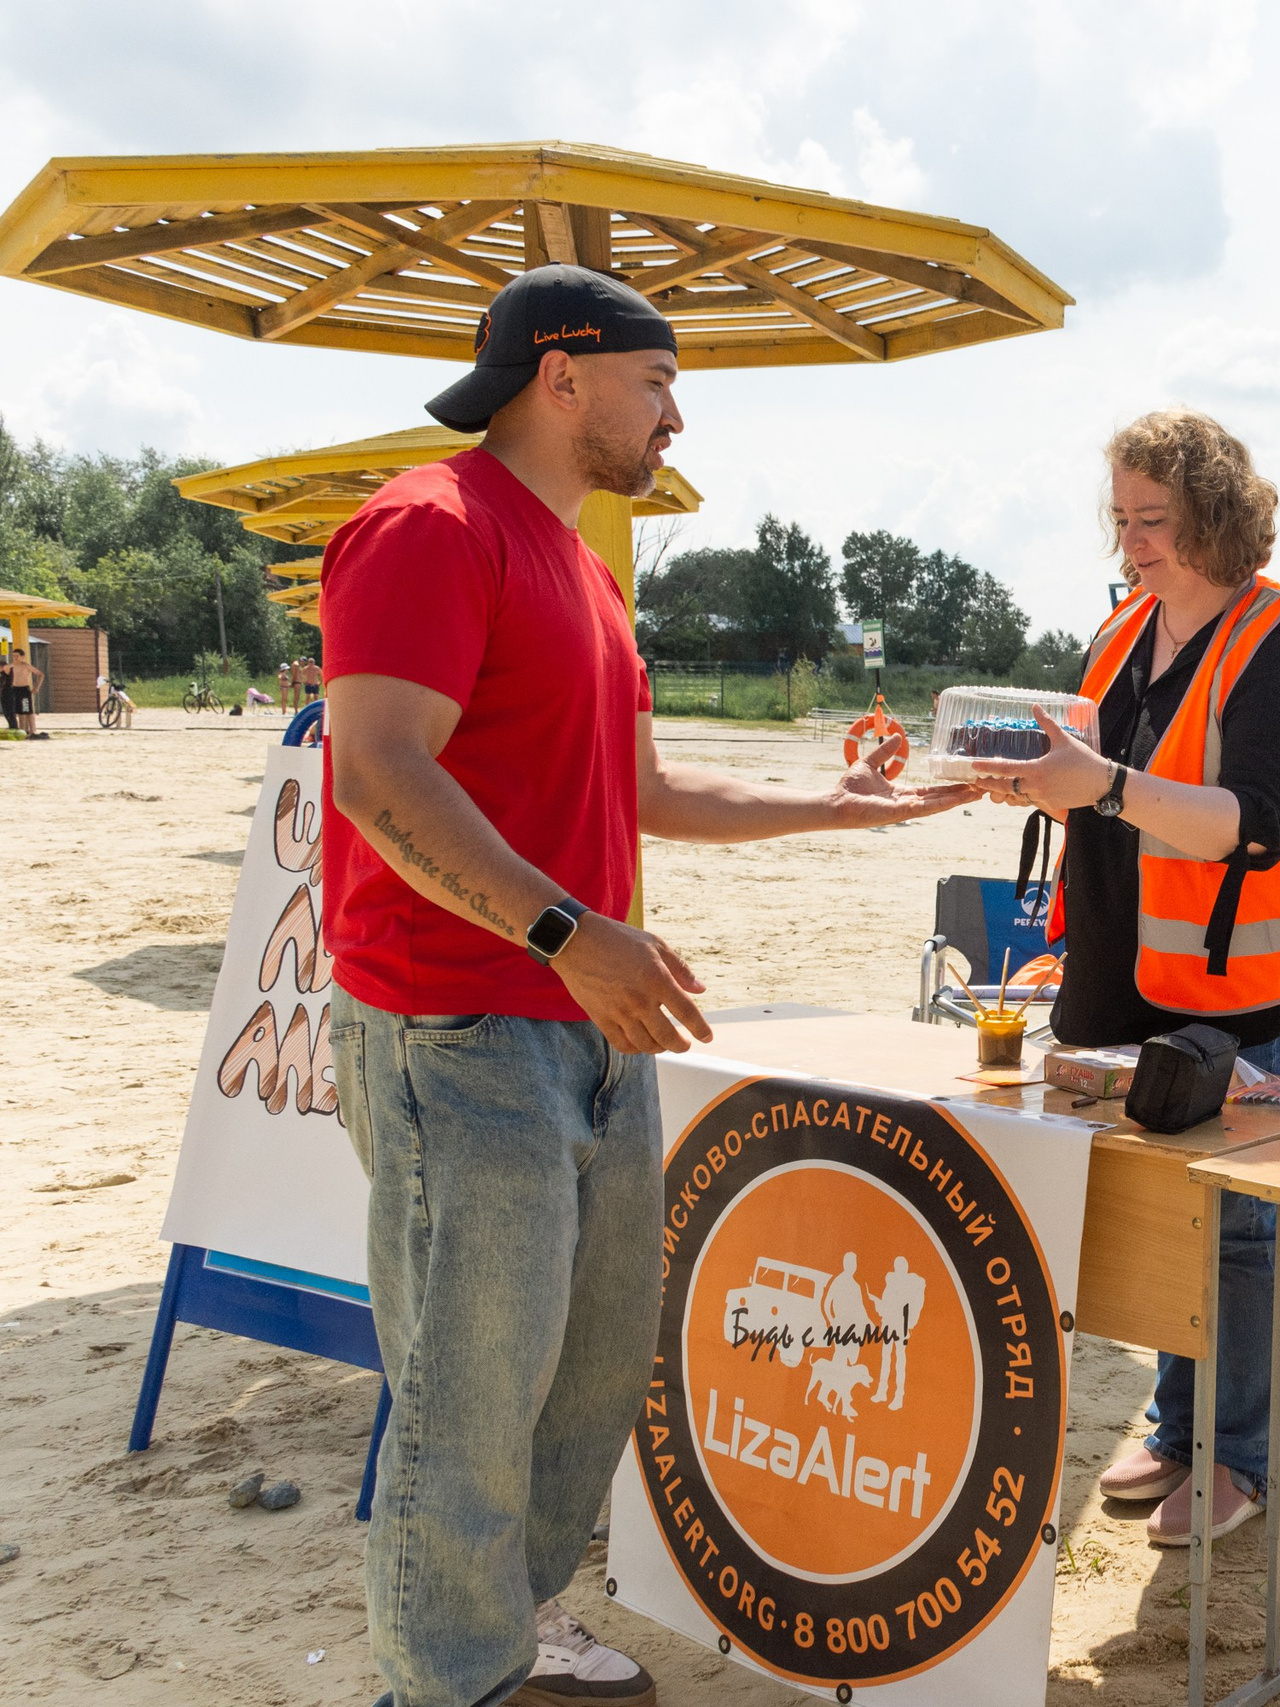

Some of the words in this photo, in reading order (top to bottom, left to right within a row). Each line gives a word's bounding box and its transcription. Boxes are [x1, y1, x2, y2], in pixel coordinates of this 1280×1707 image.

[534, 330, 559, 344] Live
[562, 322, 601, 342] Lucky
[374, 809, 440, 879] Navigate
[441, 873, 468, 900] the
[470, 892, 515, 936] Chaos
[1069, 1066, 1095, 1081] ГУАШЬ
[1080, 1079, 1088, 1089] 12
[660, 1099, 997, 1306] ИСКОВО-СПАСАТЕЛЬНЫЙ
[986, 1257, 1034, 1399] ОТРЯД
[731, 1307, 794, 1362] Будь
[802, 1326, 815, 1348] с
[823, 1303, 909, 1347] нами!
[703, 1388, 931, 1519] LizaAlert
[793, 1612, 815, 1648] 8
[826, 1613, 890, 1654] 800
[895, 1577, 962, 1640] 700
[957, 1527, 1002, 1586] 54
[985, 1466, 1026, 1527] 52
